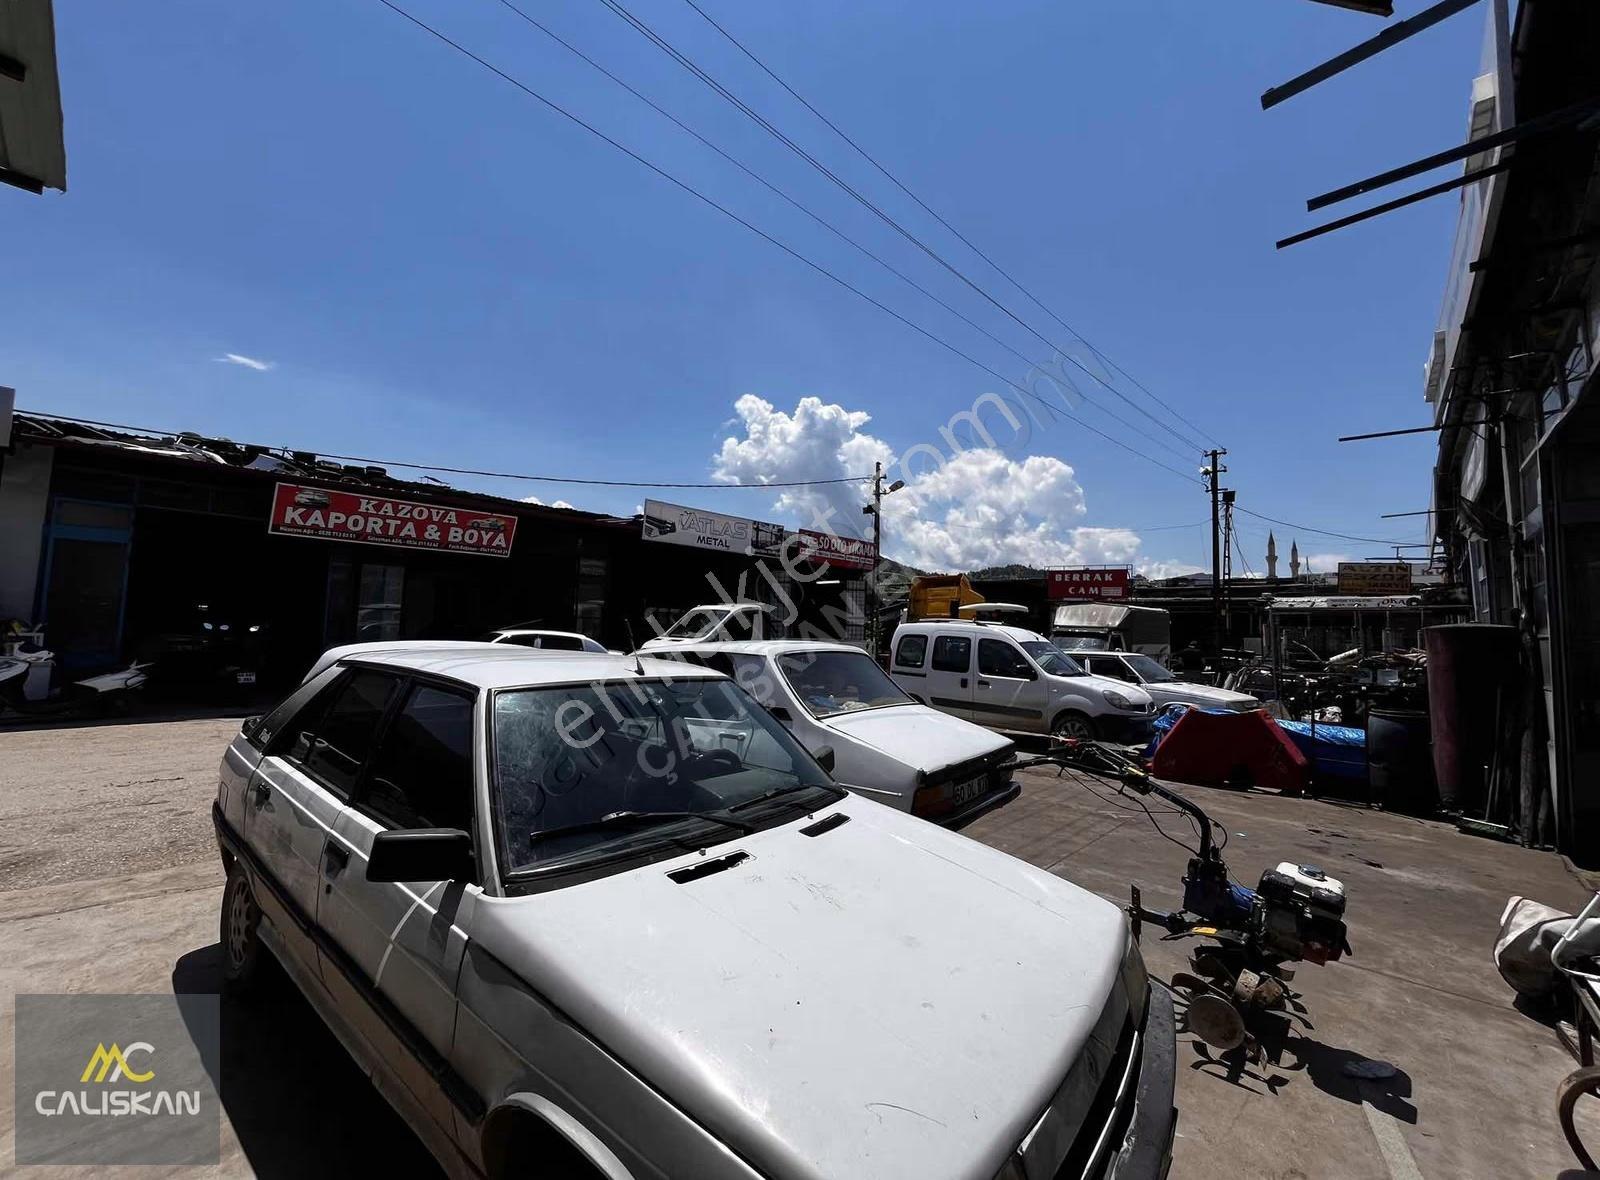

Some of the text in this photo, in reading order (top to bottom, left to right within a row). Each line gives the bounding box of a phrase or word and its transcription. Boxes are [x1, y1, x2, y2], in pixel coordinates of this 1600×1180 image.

[358, 498, 458, 525] KAZOVA
[284, 506, 417, 538] KAPORTA
[424, 524, 441, 541] &
[447, 526, 507, 548] BOYA
[680, 510, 748, 541] ATLAS
[696, 534, 731, 549] METAL
[1055, 573, 1113, 582] BERRAK
[1068, 586, 1099, 595] CAM
